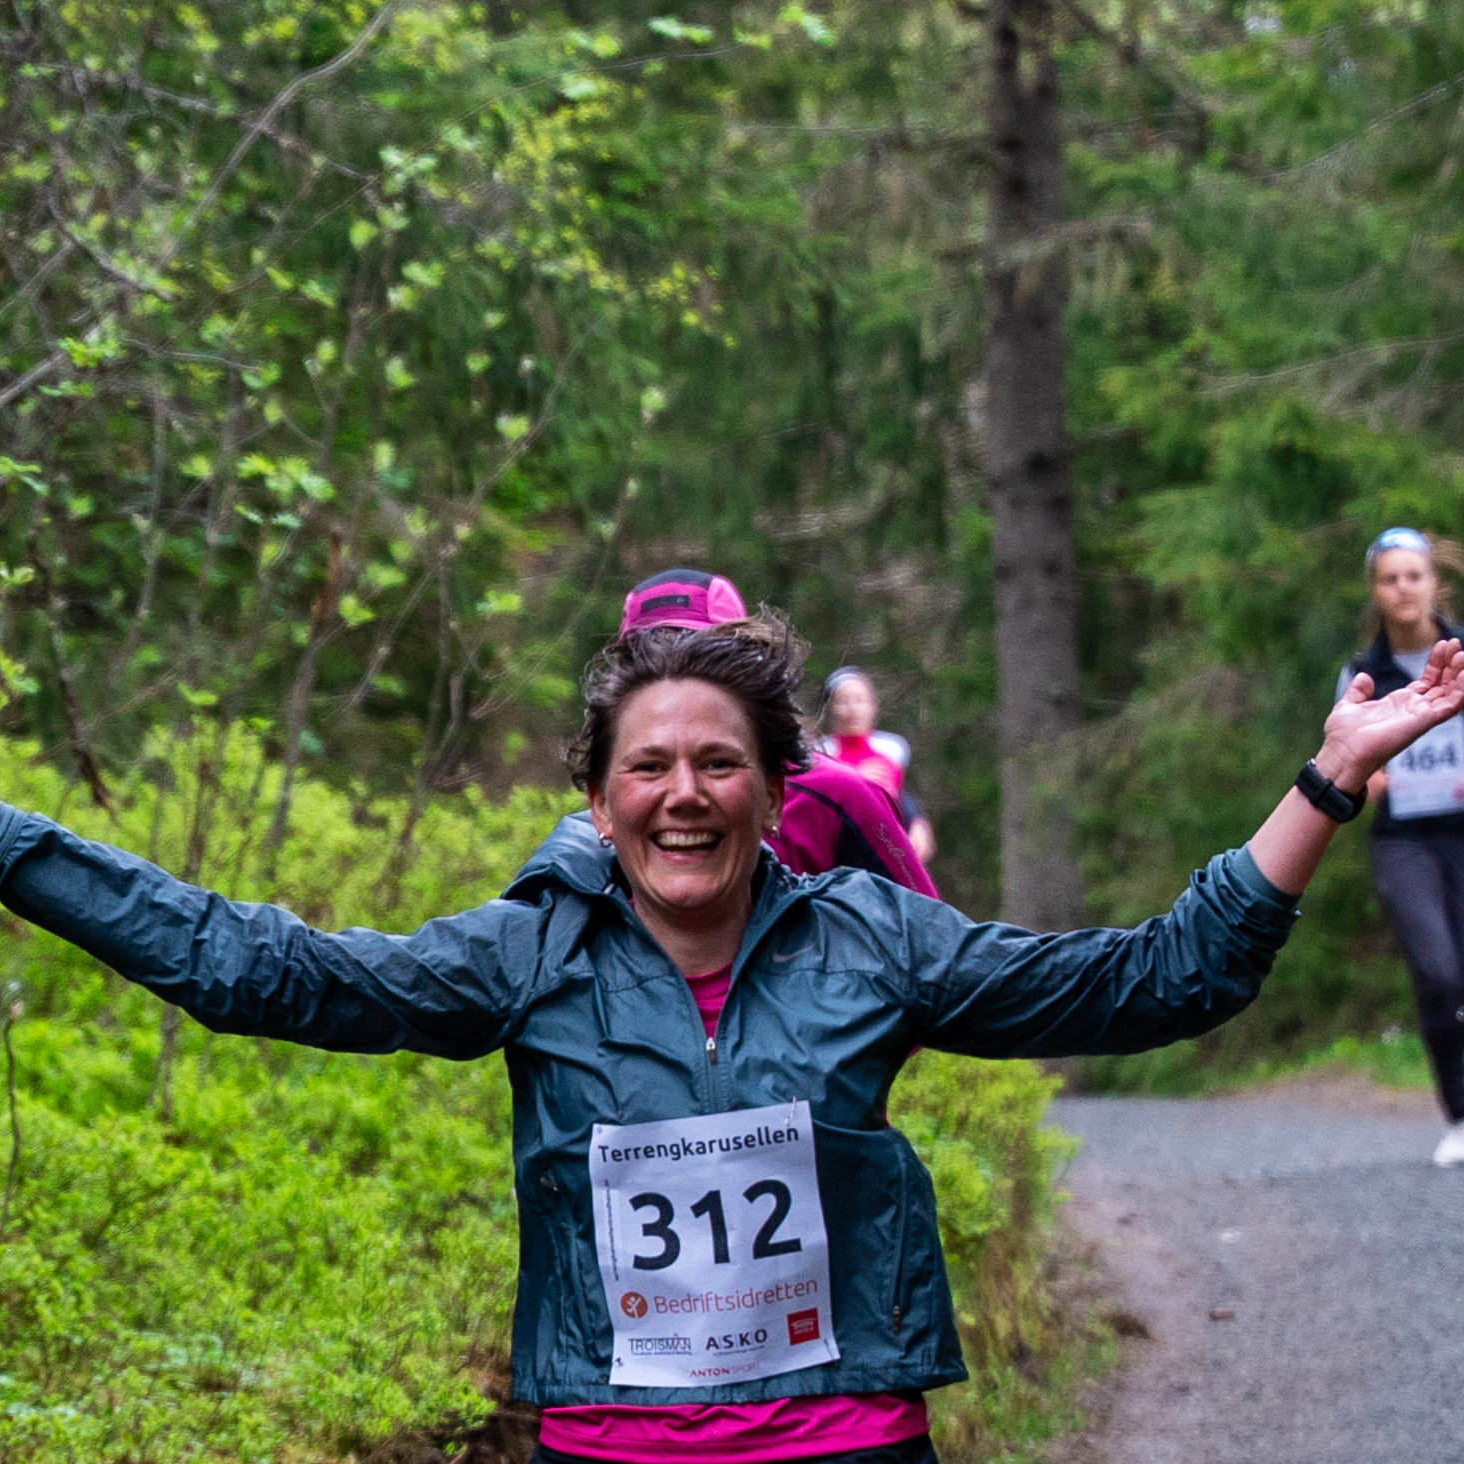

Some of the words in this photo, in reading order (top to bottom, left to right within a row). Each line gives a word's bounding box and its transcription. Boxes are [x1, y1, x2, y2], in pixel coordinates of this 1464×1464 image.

[598, 1126, 799, 1163] Terrengkarusellen
[628, 1179, 802, 1271] 312
[654, 1279, 818, 1315] Bedriftsidretten
[705, 1328, 768, 1351] ASKO
